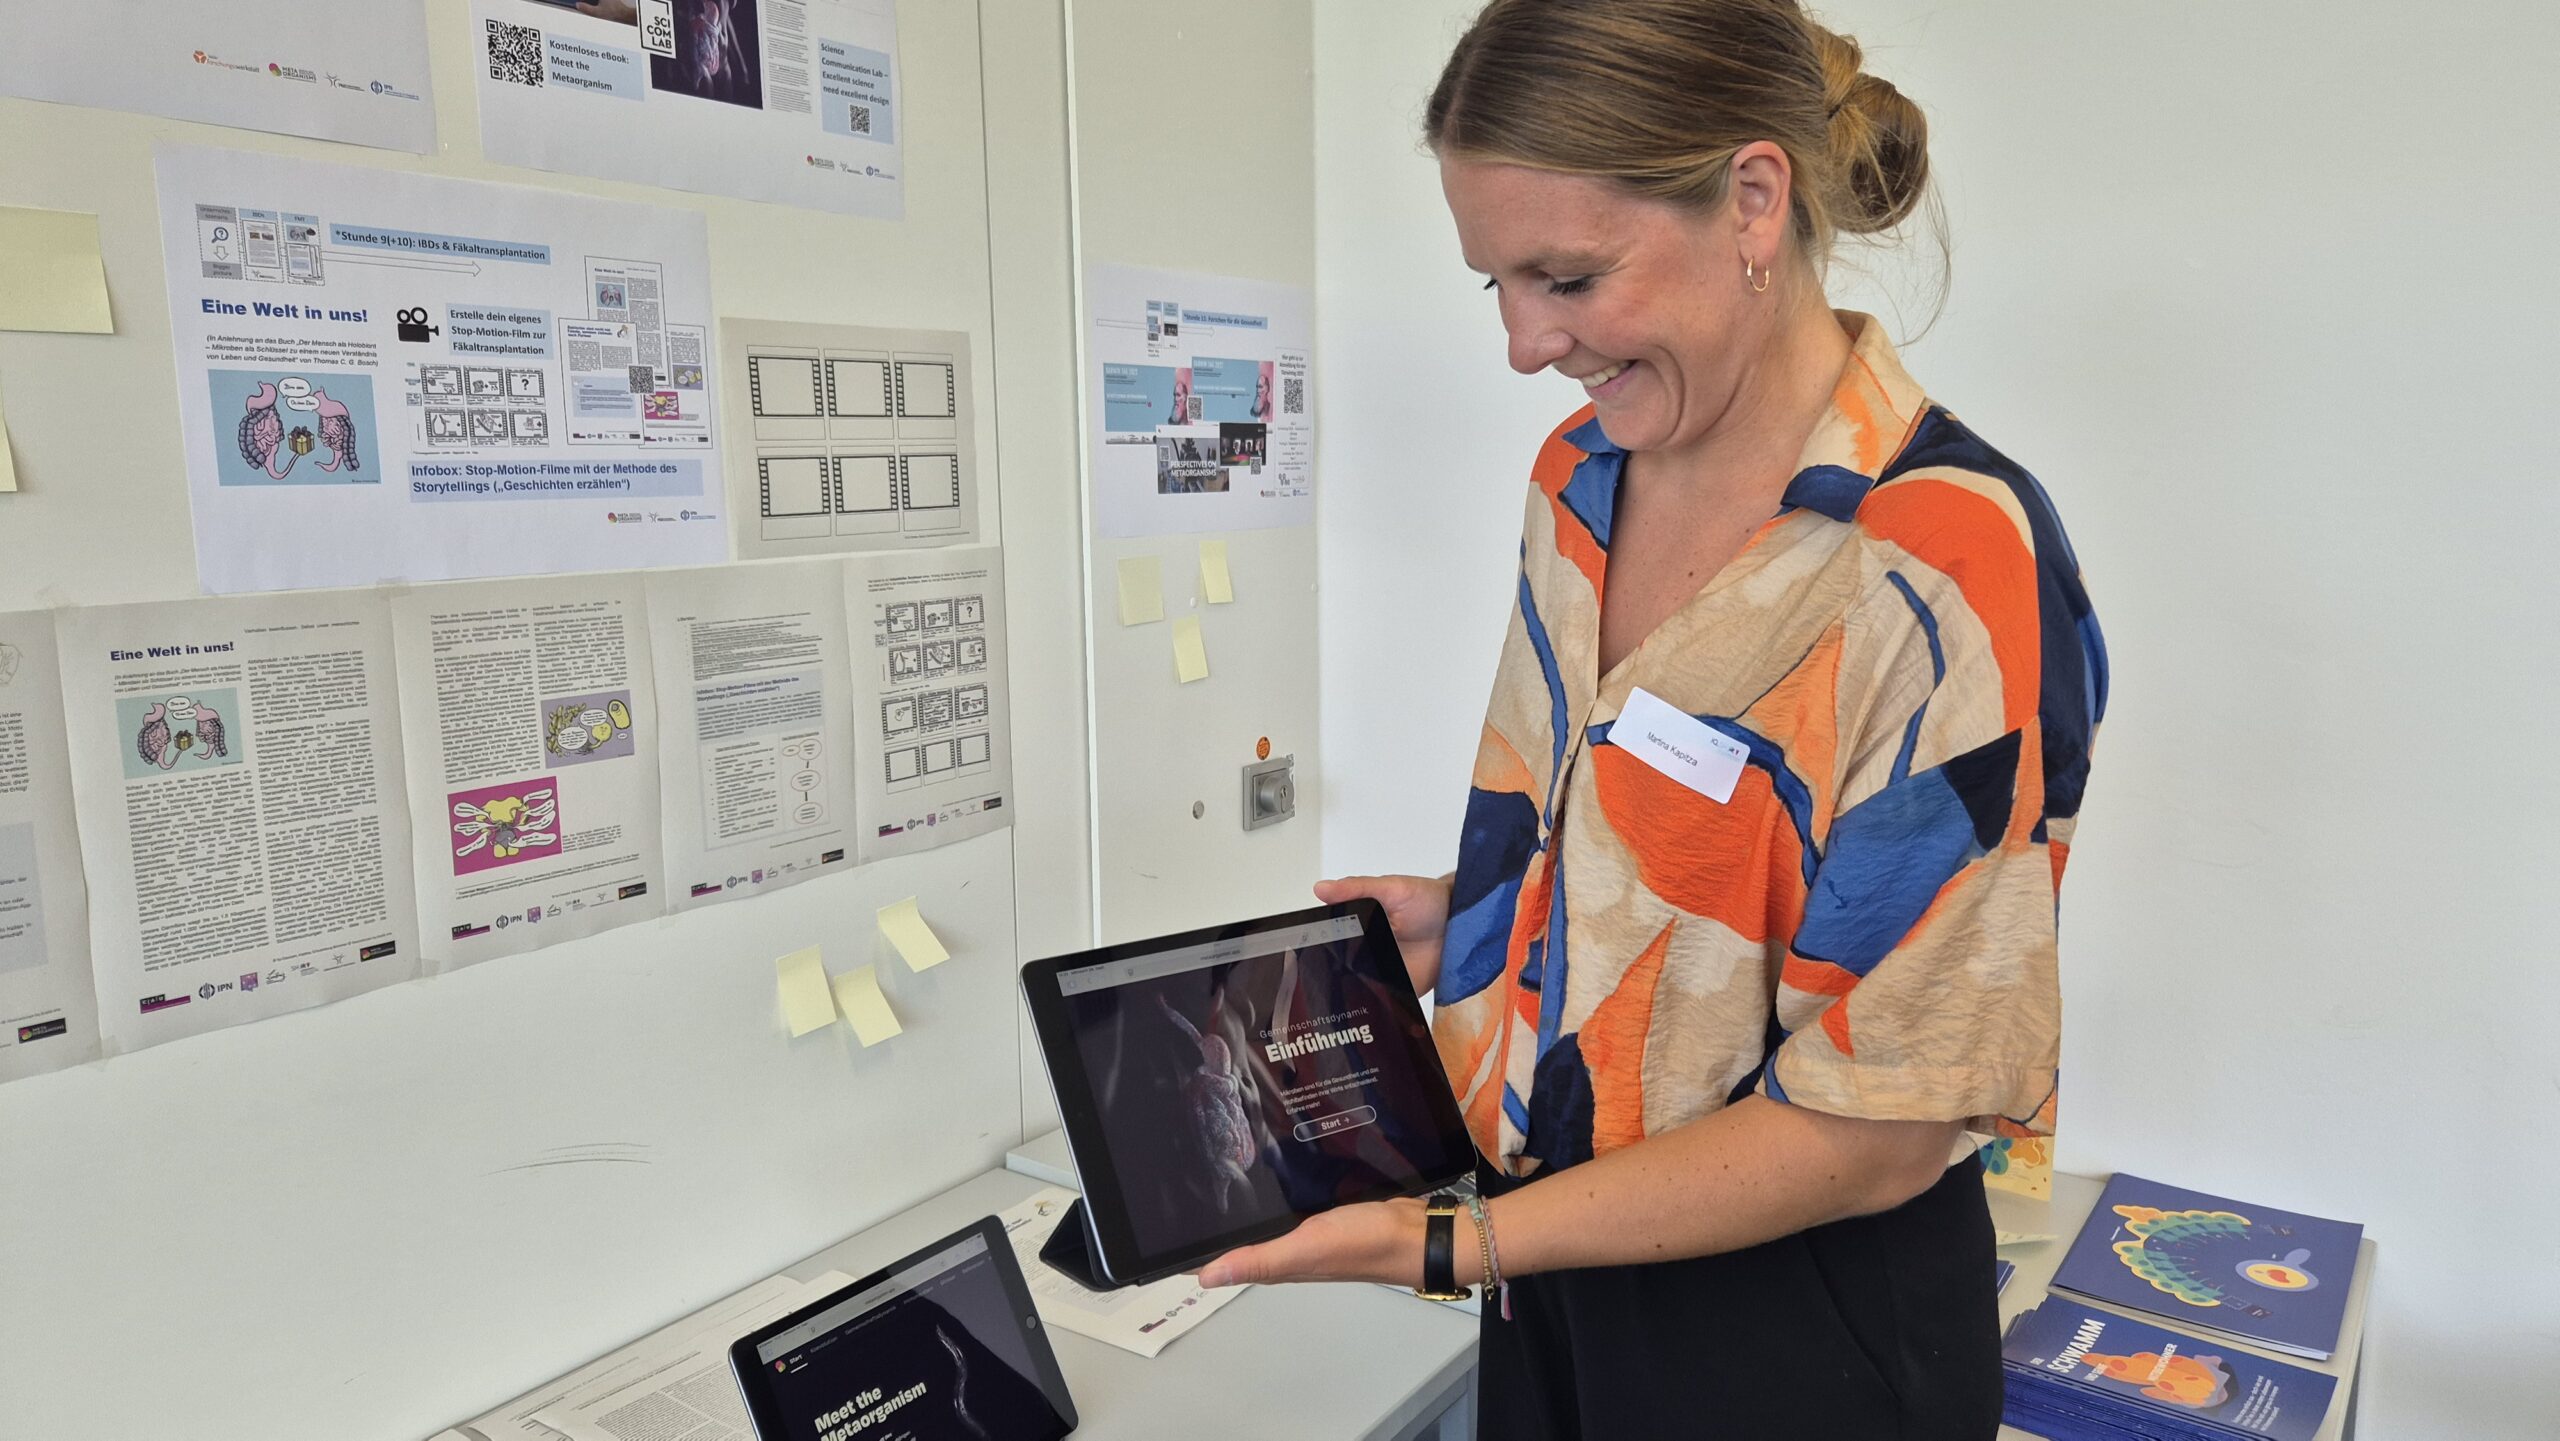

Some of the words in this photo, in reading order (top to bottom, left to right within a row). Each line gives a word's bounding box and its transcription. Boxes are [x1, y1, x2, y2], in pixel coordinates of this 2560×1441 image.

[654, 16, 671, 28] SCI
[647, 25, 672, 39] COM
[652, 36, 672, 49] LAB
[821, 43, 845, 56] Science
[549, 40, 599, 58] Kostenloses
[601, 52, 629, 64] eBook:
[551, 56, 574, 68] Meet
[576, 61, 590, 71] the
[821, 57, 871, 75] Communication
[872, 69, 884, 78] Lab
[552, 72, 612, 91] Metaorganism
[822, 71, 851, 84] Excellent
[852, 78, 875, 89] science
[823, 86, 839, 95] need
[840, 88, 868, 101] excellent
[869, 94, 889, 106] design
[381, 235, 416, 248] 9(+10):
[418, 240, 440, 250] IBDs
[442, 242, 450, 250] &
[453, 243, 545, 260] Fäkaltransplantation
[202, 299, 247, 315] Eine
[252, 302, 299, 318] Welt
[305, 306, 322, 319] in
[329, 309, 368, 322] uns!
[450, 309, 484, 321] Erstelle
[486, 311, 506, 322] dein
[508, 313, 542, 325] eigenes
[451, 325, 531, 340] Stop-Motion-Film
[533, 332, 546, 340] zur
[453, 342, 544, 356] Fäkaltransplantation
[411, 465, 462, 478] Infobox:
[465, 464, 571, 477] Stop-Motion-Filme
[574, 464, 590, 474] mit
[593, 463, 610, 474] der
[613, 463, 657, 474] Methode
[660, 463, 677, 474] des
[413, 480, 490, 494] Storytellings
[493, 479, 574, 493] („Geschichten
[576, 478, 631, 491] erzählen“)
[110, 650, 143, 661] Eine
[147, 645, 181, 658] Welt
[185, 645, 199, 654] in
[204, 641, 234, 653] uns!
[1647, 731, 1670, 751] Martina
[1670, 745, 1698, 767] Kapitza
[510, 915, 522, 924] IPN
[217, 982, 233, 993] IPN
[1260, 1007, 1369, 1039] Gemeinschaftsdynamik
[1265, 1024, 1374, 1063] Einführung
[1321, 1118, 1341, 1131] Start
[2046, 1318, 2106, 1373] SCHWAMM
[789, 1354, 803, 1365] Start
[814, 1400, 857, 1434] Meet
[855, 1387, 882, 1409] the
[820, 1382, 927, 1441] Metaorganism
